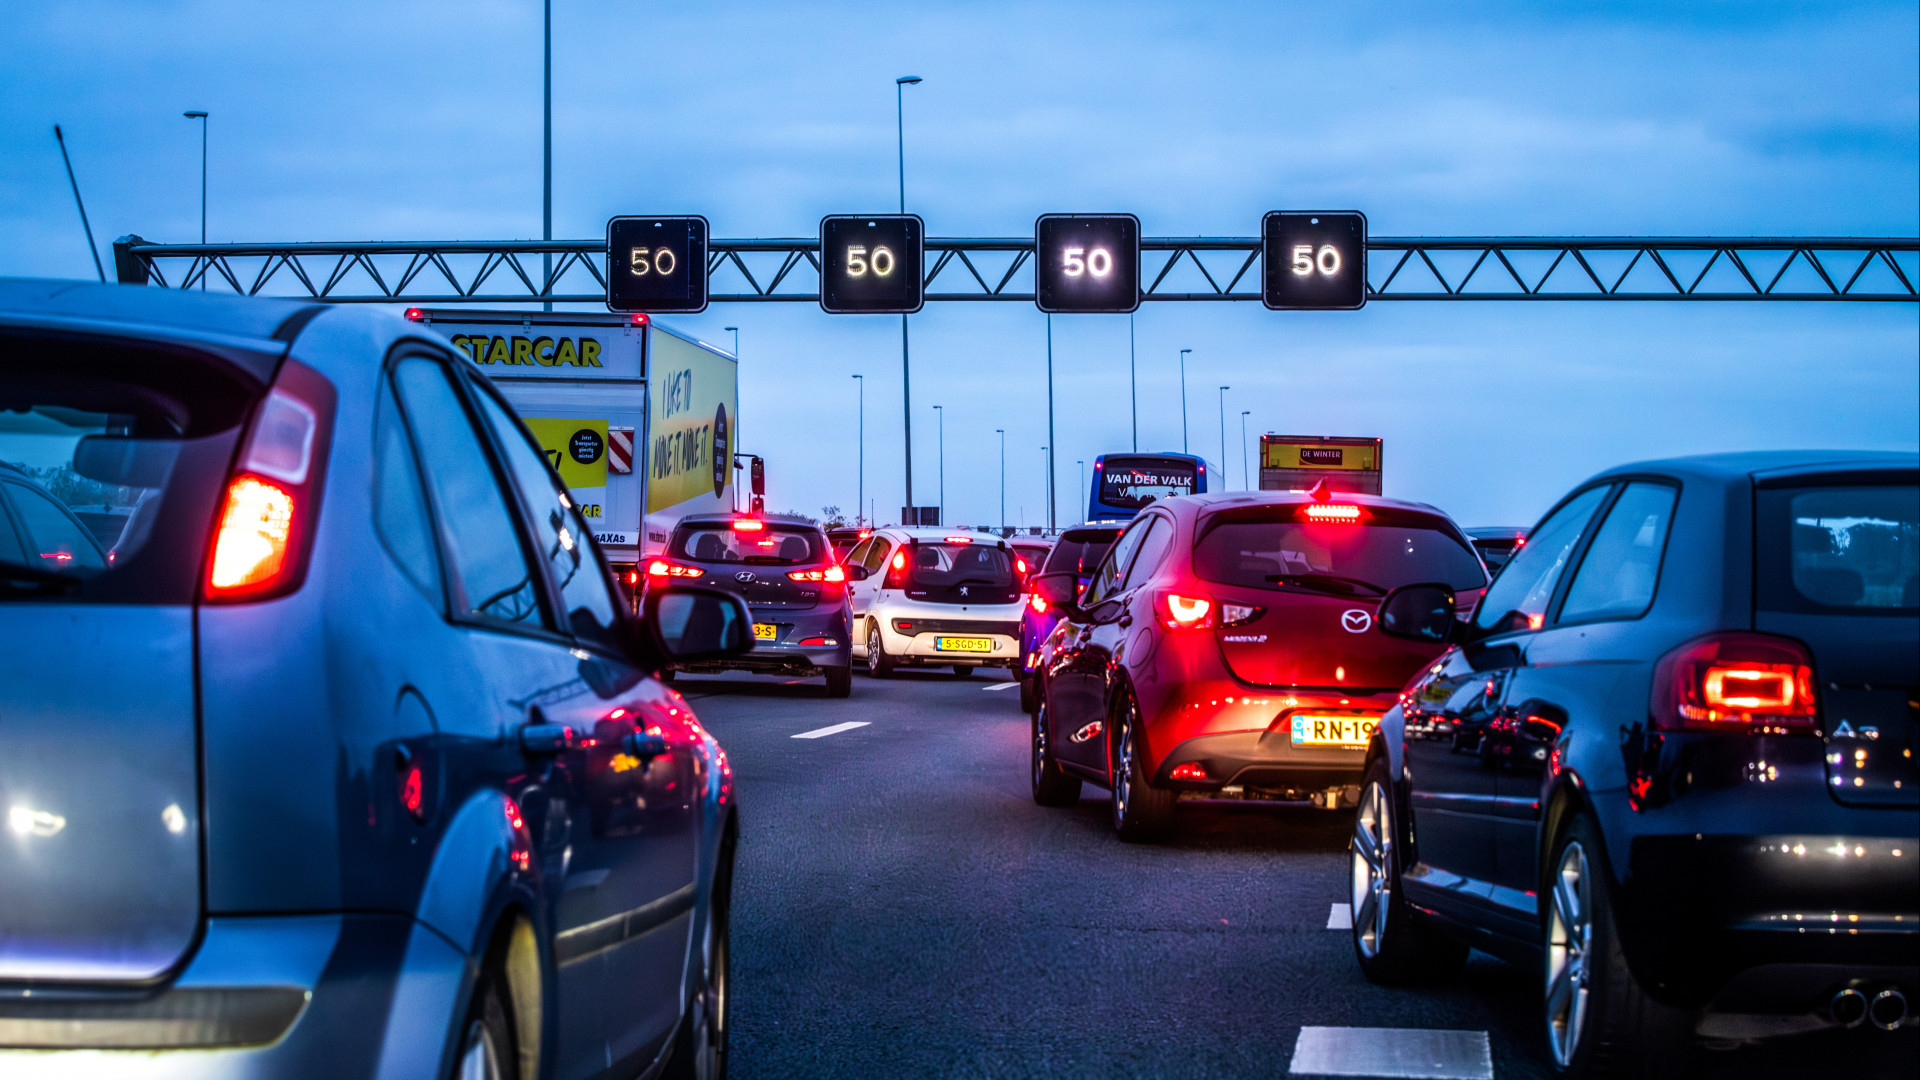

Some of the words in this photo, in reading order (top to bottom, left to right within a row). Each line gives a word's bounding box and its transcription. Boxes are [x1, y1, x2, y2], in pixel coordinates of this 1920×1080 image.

[630, 246, 676, 276] 50
[846, 245, 895, 277] 50
[1062, 247, 1113, 278] 50
[1292, 244, 1341, 276] 50
[451, 334, 603, 368] STARCAR
[667, 370, 682, 420] LIKE
[653, 433, 674, 480] MOVE
[1302, 450, 1311, 458] DE
[1313, 450, 1341, 458] WINTER
[1106, 474, 1131, 484] VAN
[1134, 474, 1158, 485] DER
[1161, 475, 1192, 486] VALK
[946, 638, 988, 650] 5-SGD-51
